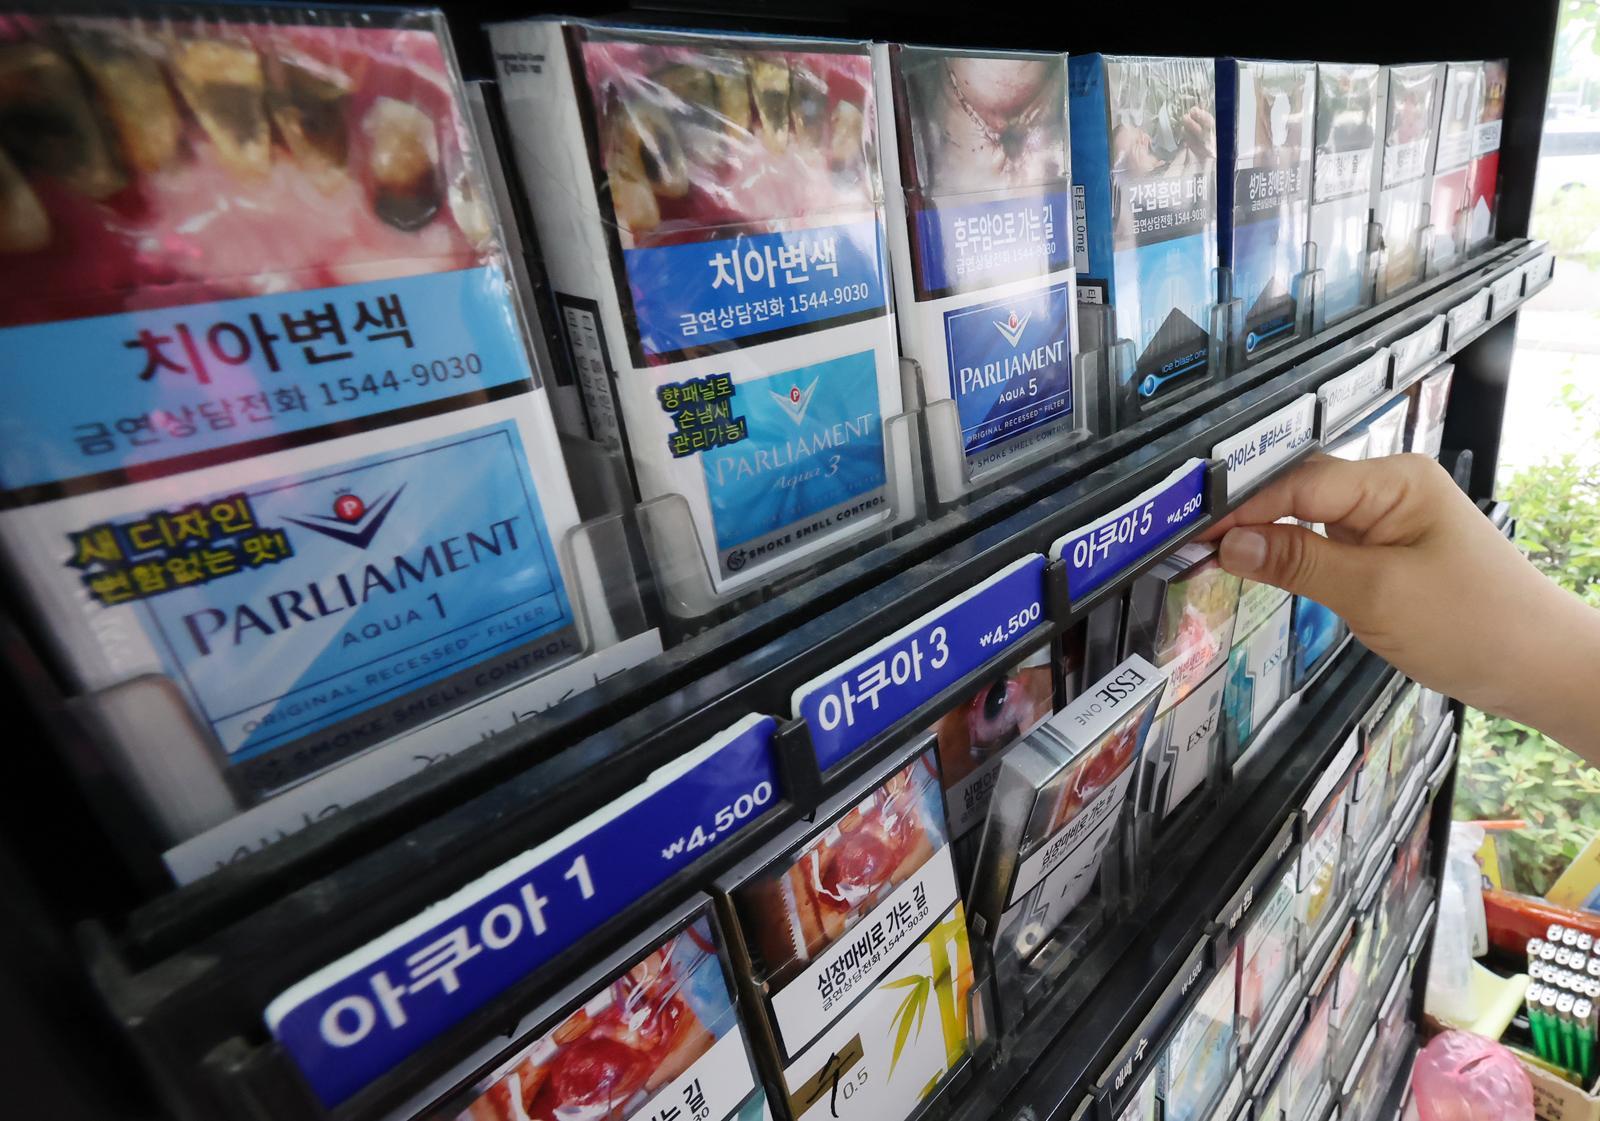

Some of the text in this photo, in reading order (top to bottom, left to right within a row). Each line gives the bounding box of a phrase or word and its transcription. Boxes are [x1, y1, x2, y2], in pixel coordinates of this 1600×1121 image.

[1129, 176, 1207, 213] 간접흡연 피해
[954, 203, 1054, 256] 후두암으로 가는 길
[1133, 213, 1173, 233] 금연상담전화
[709, 238, 839, 293] 치아변색
[679, 283, 869, 337] 금연상담전화 1544-9030
[123, 292, 415, 385] 치아변색
[960, 340, 1064, 395] PARLIAMENT
[999, 377, 1038, 404] AQUA 5
[73, 352, 482, 457] 금연상담전화 1544-9030
[967, 425, 1005, 443] ORIGINAL
[1044, 398, 1065, 412] FILTER
[716, 413, 873, 487] PARLIAMENT
[774, 454, 841, 490] Aqua 3
[977, 450, 1007, 468] SMOKE
[1227, 441, 1256, 473] 아이스
[1258, 418, 1293, 456] 블라스트
[77, 498, 254, 565] 새 디자인
[242, 532, 289, 566] 맛!
[750, 495, 886, 560] SMOKE SMELL CONTROL
[1073, 492, 1203, 571] 아쿠아 5 ₩4,500
[180, 516, 522, 658] PARLIAMENT
[341, 591, 448, 649] AQUA 1
[242, 680, 360, 735] ORIGINAL
[487, 606, 547, 639] FILTER
[818, 601, 1042, 733] 아쿠아 3 ₩4,500
[1095, 667, 1147, 709] ESSE
[293, 717, 389, 763] SMOKE
[393, 683, 470, 722] SMELL
[474, 637, 573, 688] CONTROL
[1074, 703, 1102, 727] ONE
[1186, 711, 1217, 752] ESSE
[318, 779, 774, 1050] 아쿠아 1 ₩4,500
[816, 881, 927, 997] 심장마비로 가는 길
[821, 905, 930, 1012] 금연상담전화 1544-9030
[683, 1078, 706, 1114] 길
[842, 1066, 869, 1101] 0.5
